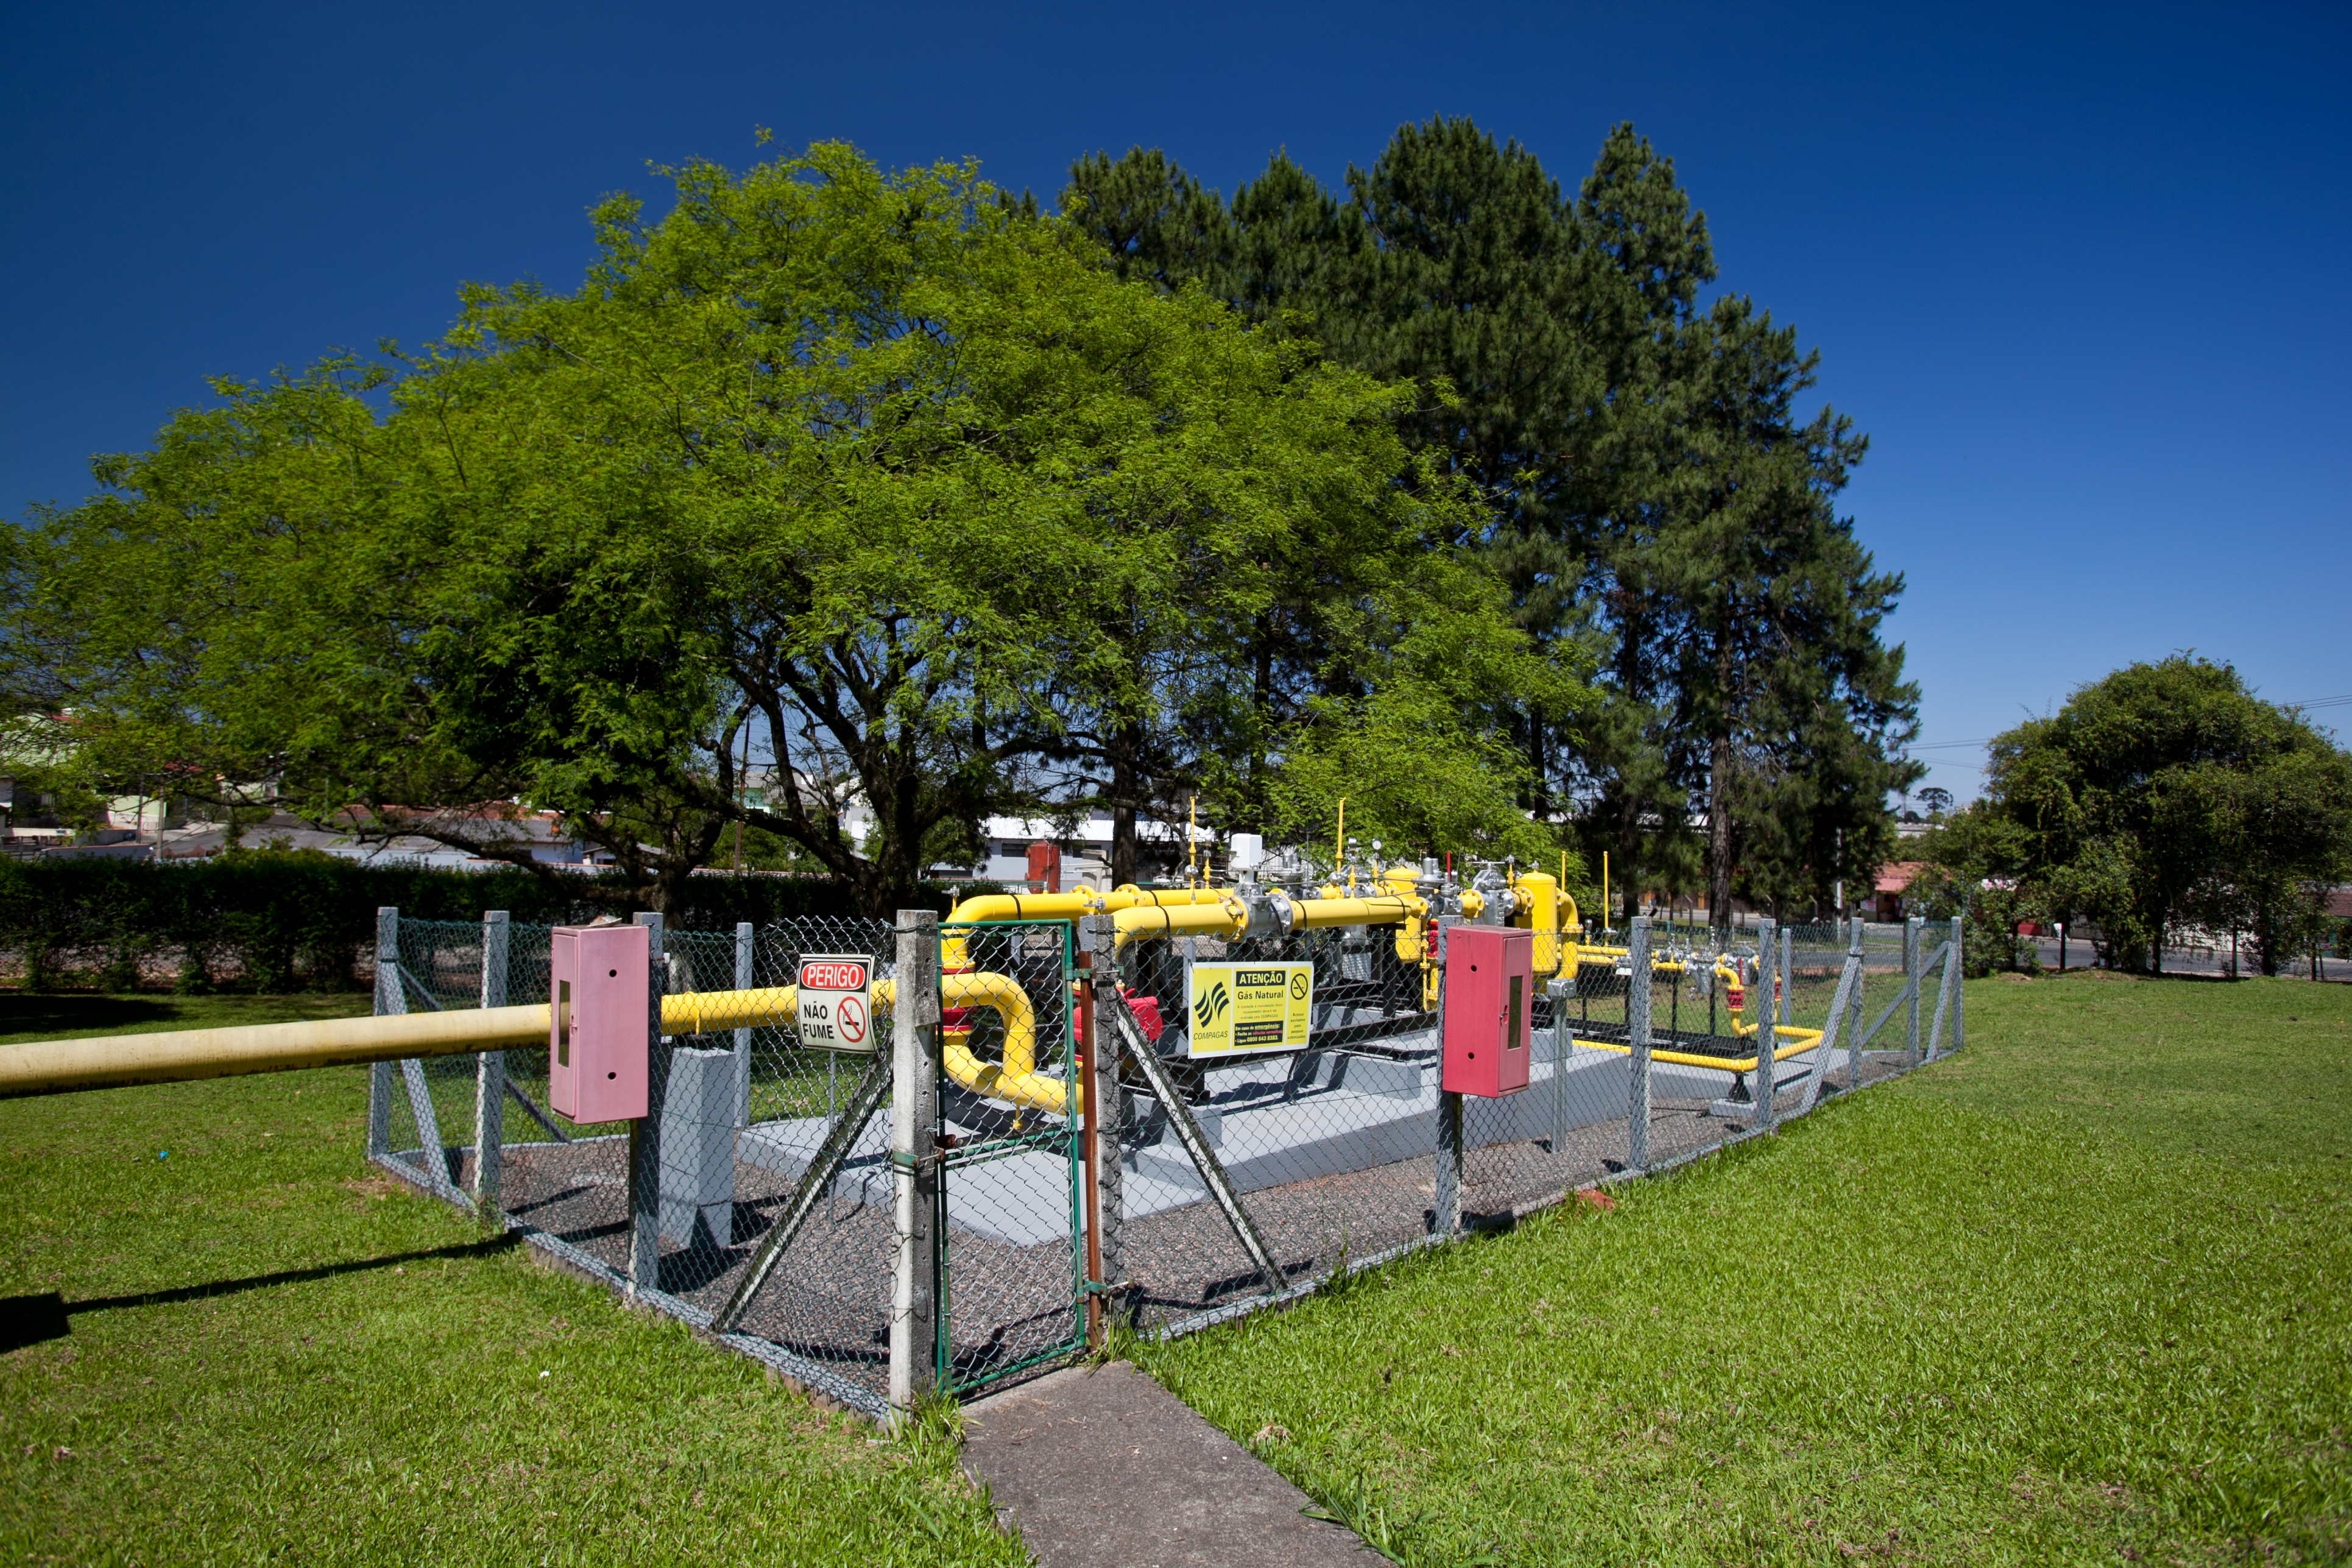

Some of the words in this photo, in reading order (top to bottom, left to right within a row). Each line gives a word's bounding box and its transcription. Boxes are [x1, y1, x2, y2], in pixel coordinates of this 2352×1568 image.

[807, 966, 859, 987] PERIGO
[1239, 971, 1283, 986] ATENÇÃO
[1237, 991, 1252, 1000] Gás
[1255, 990, 1284, 999] Natural
[803, 1001, 828, 1020] NÃO
[802, 1023, 835, 1039] FUME
[1193, 1031, 1228, 1040] COMPAGAS
